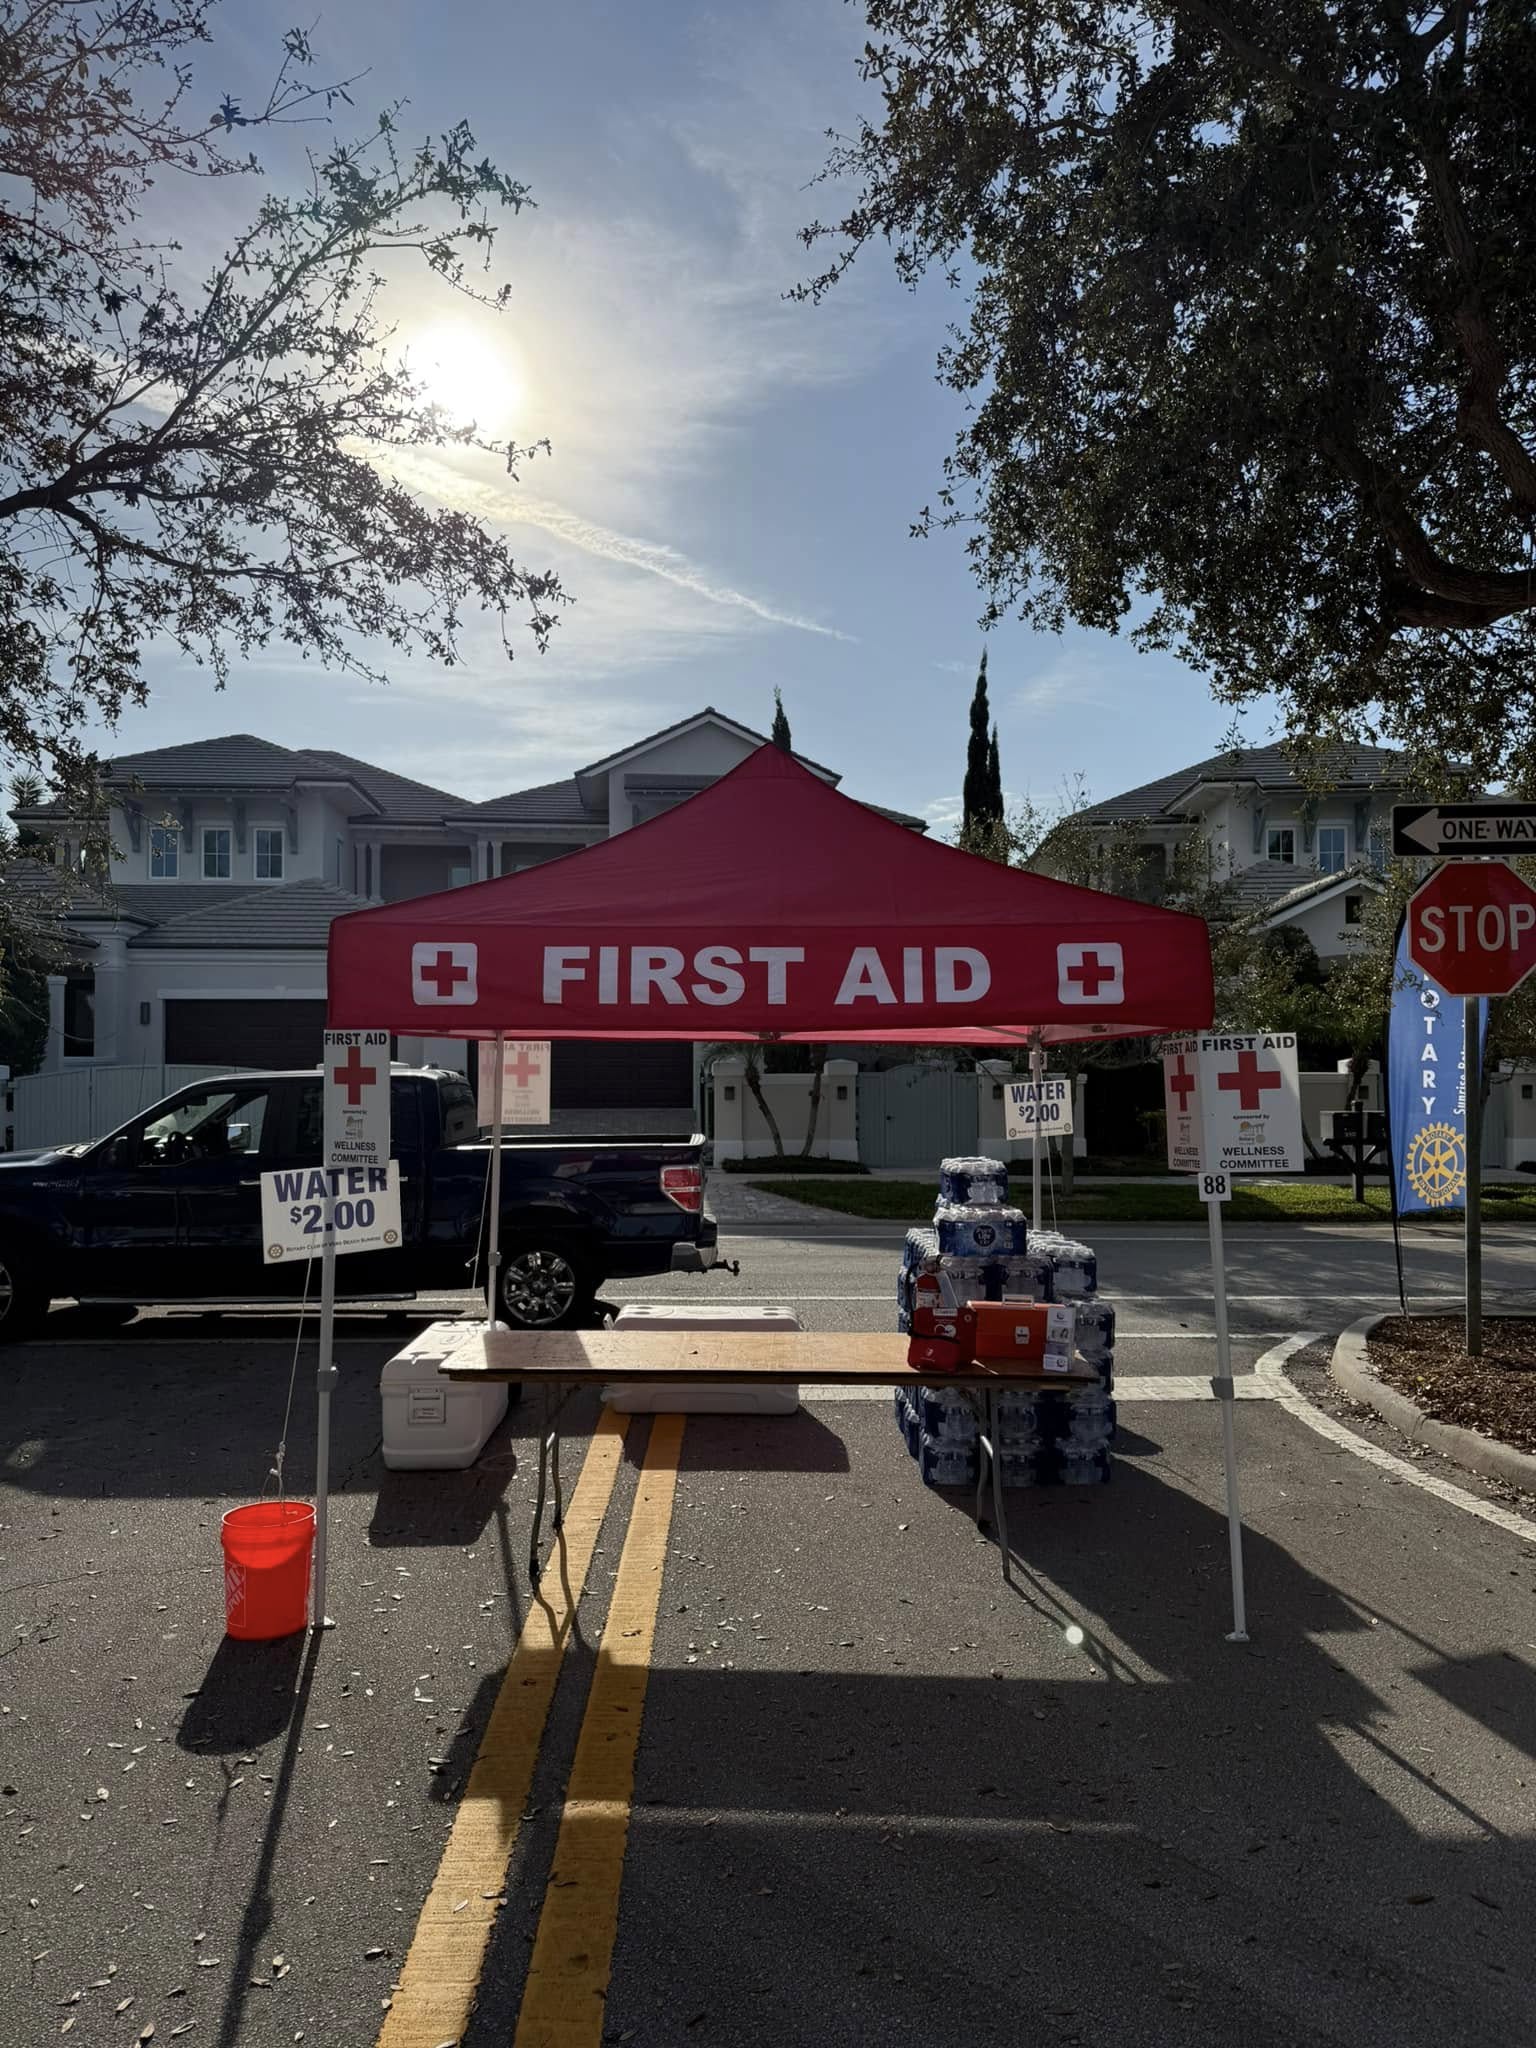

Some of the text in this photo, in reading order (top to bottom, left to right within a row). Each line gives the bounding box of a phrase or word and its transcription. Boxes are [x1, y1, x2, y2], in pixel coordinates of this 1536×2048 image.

[1442, 820, 1487, 840] ONE
[1418, 903, 1536, 953] STOP
[543, 946, 992, 1006] FIRST AID
[324, 1032, 387, 1046] FIRST AID
[1163, 1040, 1198, 1055] FIRST AID
[1202, 1036, 1295, 1051] FIRST AID
[1420, 974, 1440, 1115] OTARY
[1011, 1082, 1065, 1103] WATER
[1018, 1103, 1060, 1124] $2.00
[334, 1141, 376, 1152] WELLNESS
[1222, 1146, 1285, 1157] WELLNESS
[331, 1152, 379, 1164] COMMITTEE
[1219, 1158, 1289, 1169] COMMITTEE
[274, 1166, 388, 1202] WATER
[1204, 1175, 1226, 1195] 88
[290, 1199, 375, 1235] $2.00
